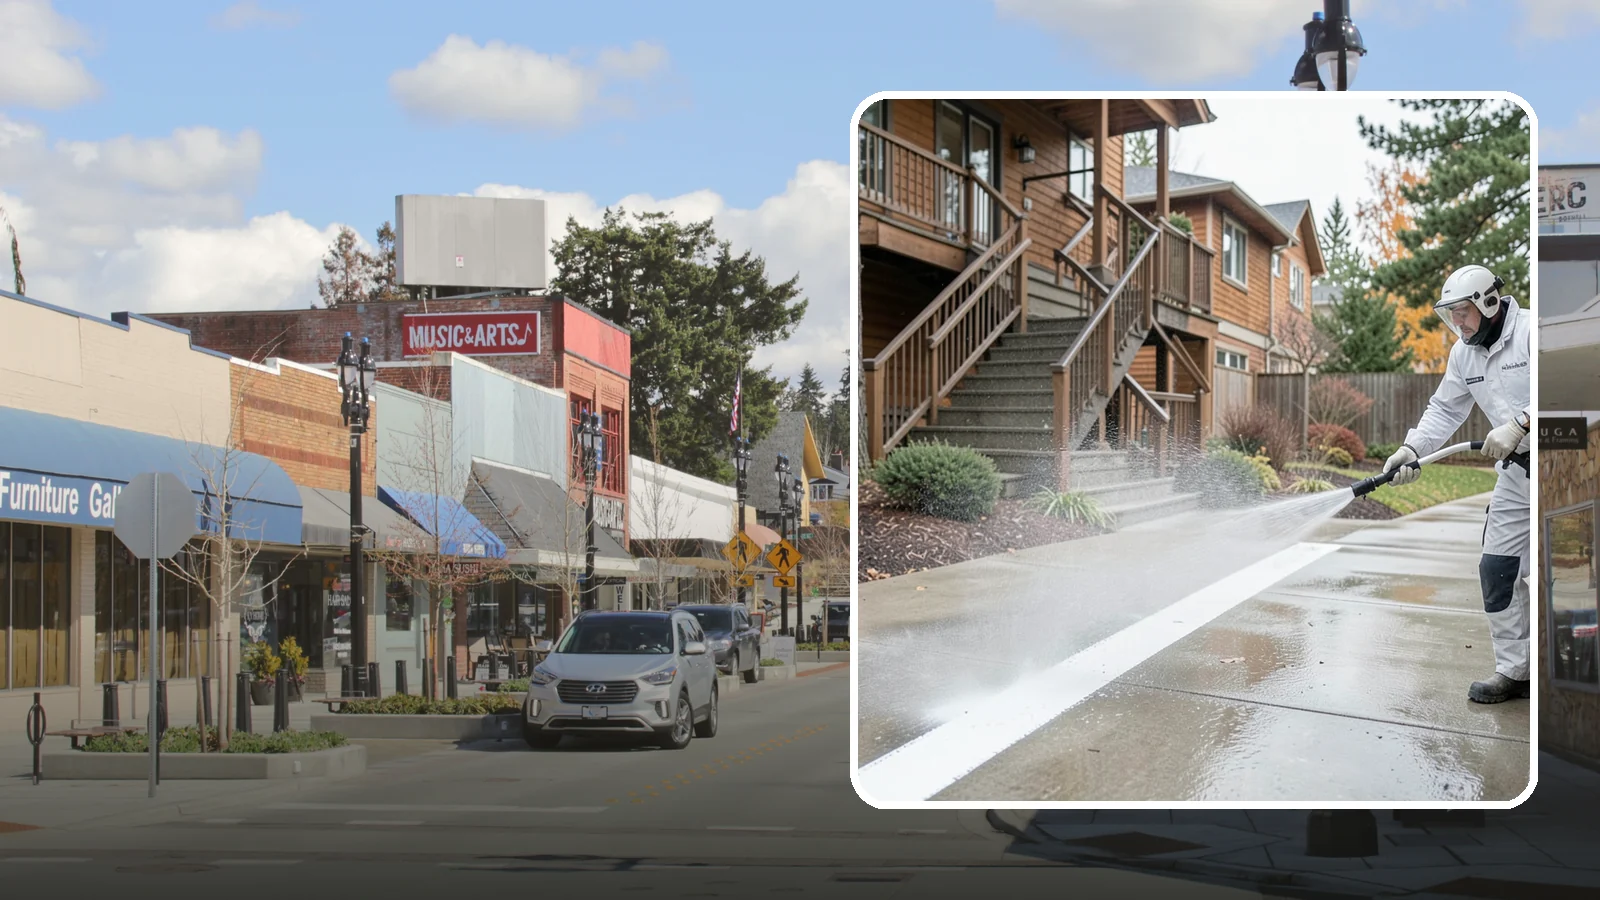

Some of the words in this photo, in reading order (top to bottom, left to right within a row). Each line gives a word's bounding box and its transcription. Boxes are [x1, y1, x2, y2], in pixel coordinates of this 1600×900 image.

[0, 472, 79, 515] Furniture
[89, 483, 121, 518] Gal
[453, 563, 480, 574] SUSHI
